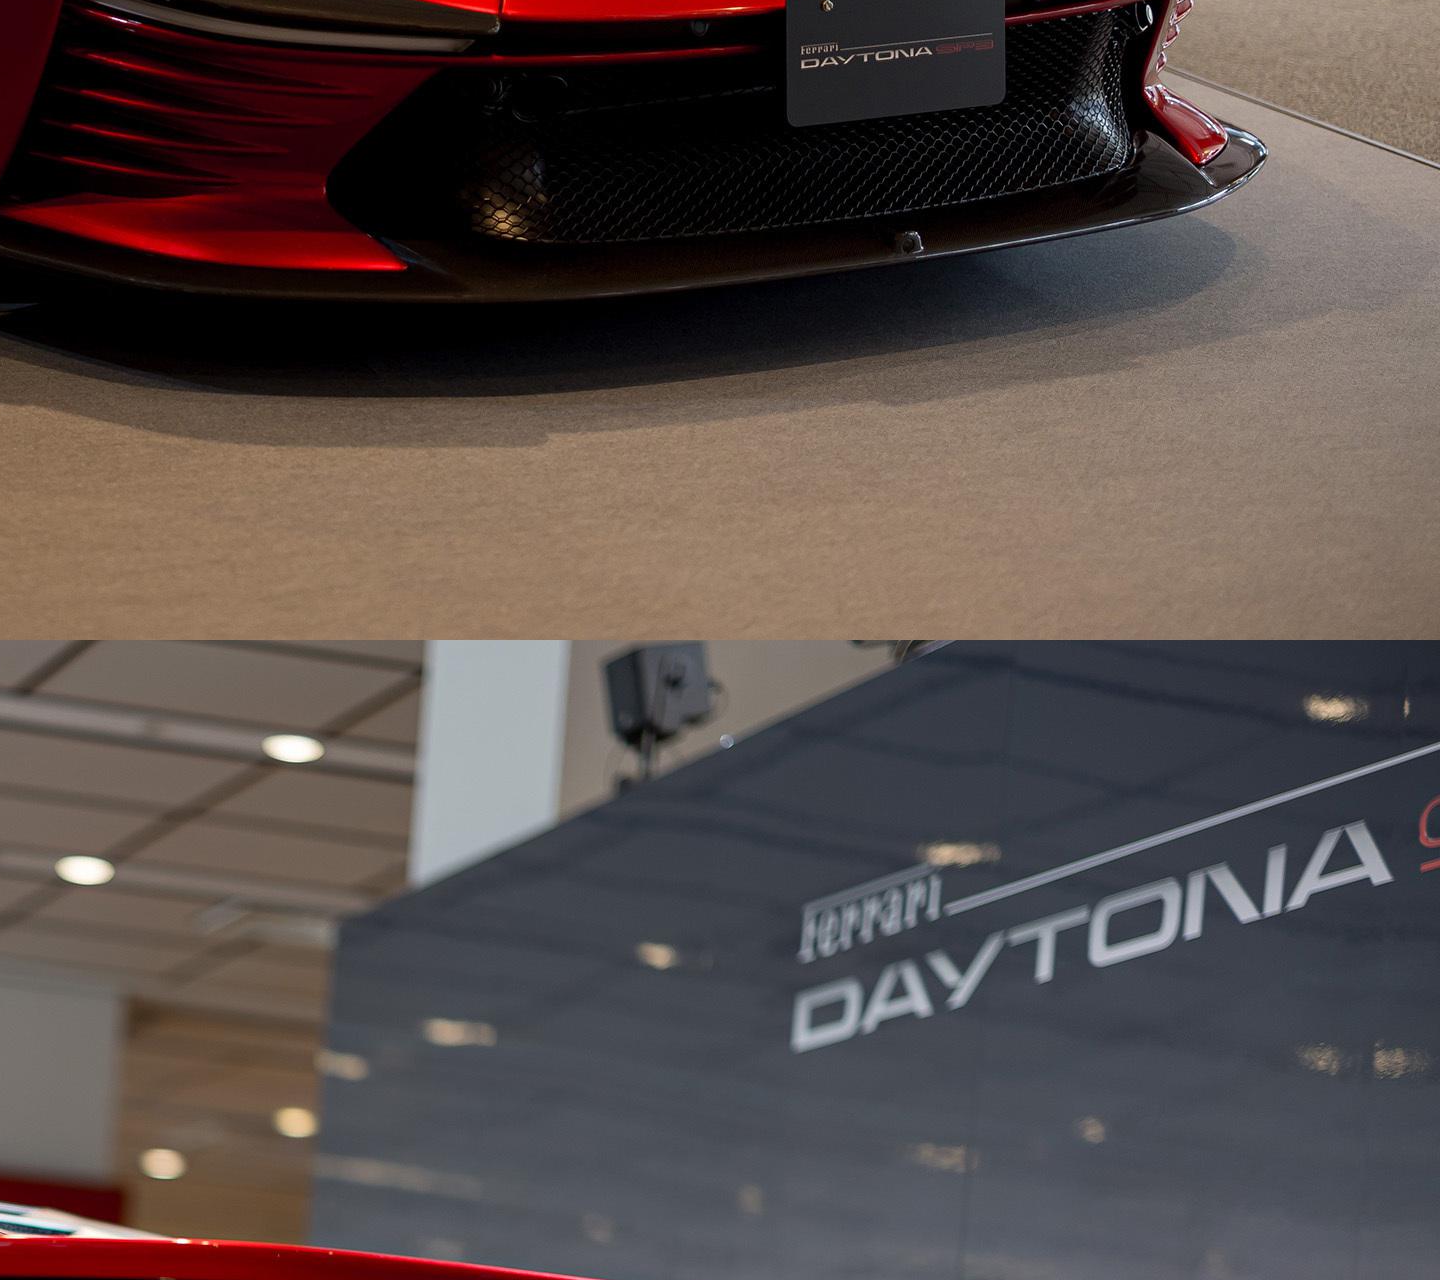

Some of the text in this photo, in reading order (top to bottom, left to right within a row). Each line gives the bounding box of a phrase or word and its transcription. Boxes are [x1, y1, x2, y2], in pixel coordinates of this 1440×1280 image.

[800, 42, 839, 56] Ferrari
[800, 39, 994, 69] DAYTONA SP3
[790, 820, 1395, 1054] DAYTONA
[796, 863, 944, 964] Ferrari
